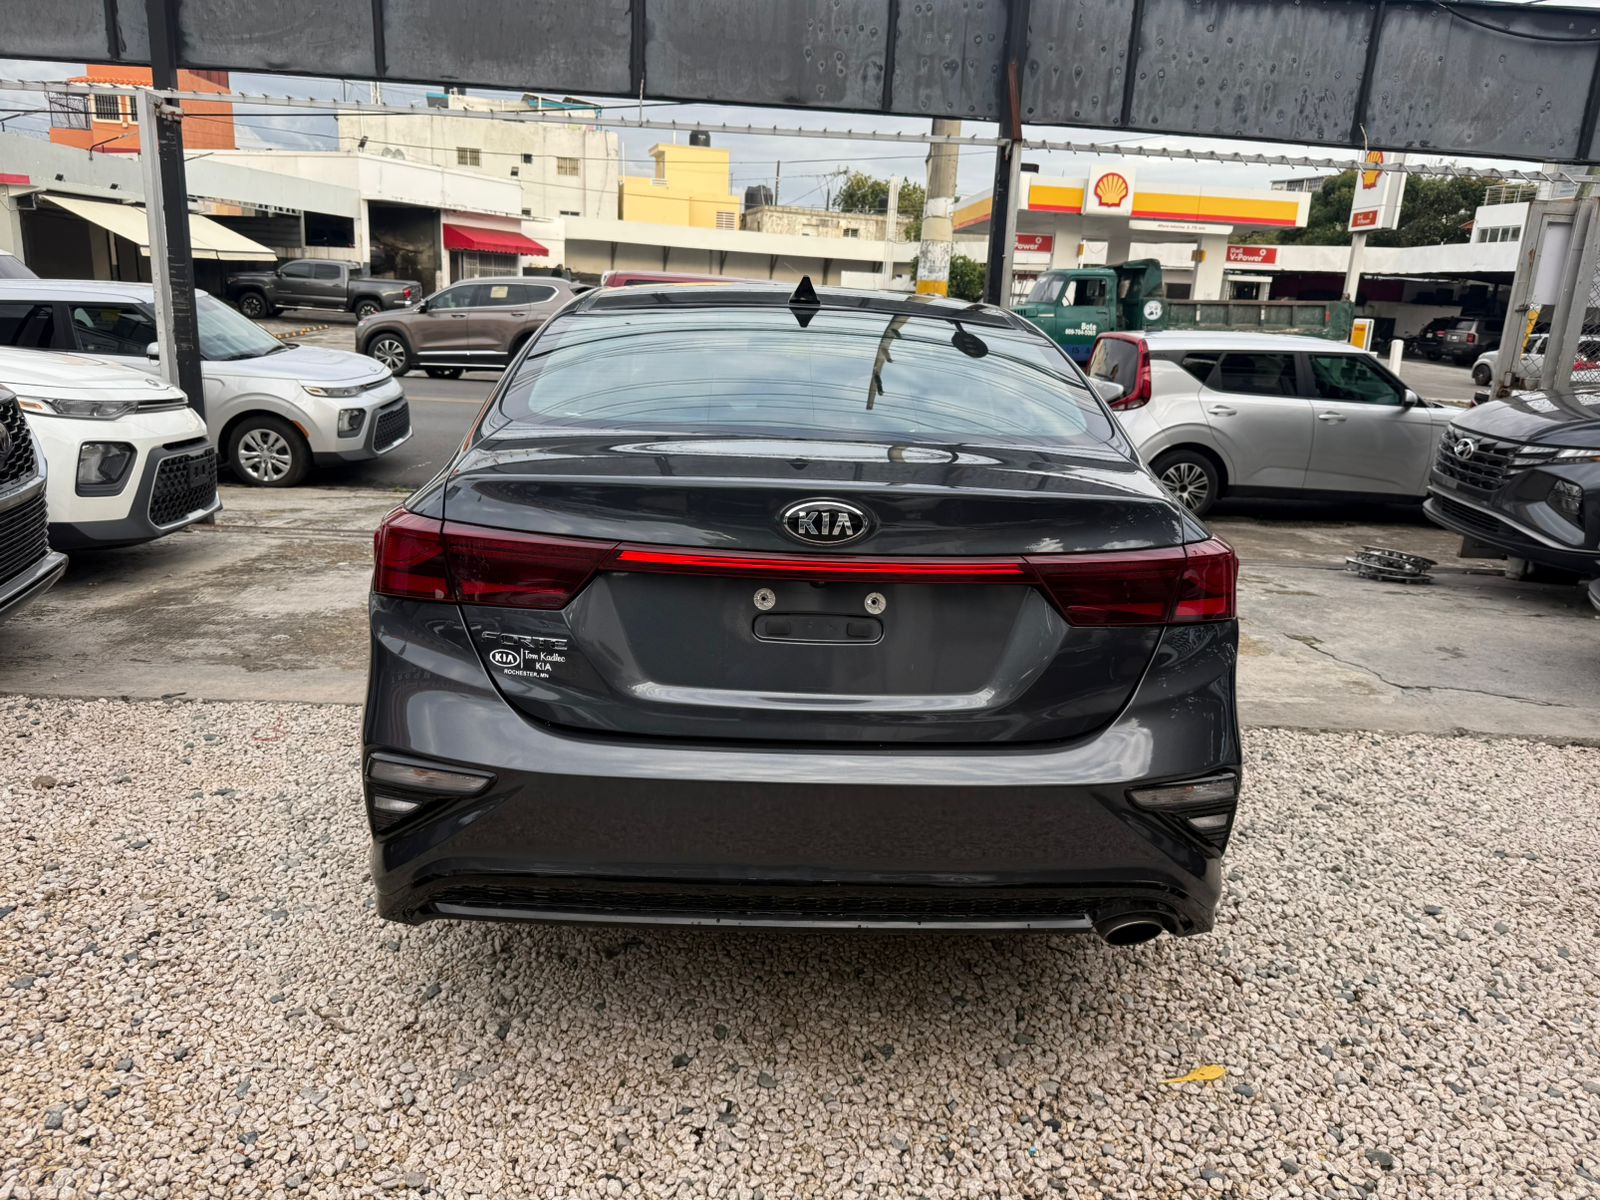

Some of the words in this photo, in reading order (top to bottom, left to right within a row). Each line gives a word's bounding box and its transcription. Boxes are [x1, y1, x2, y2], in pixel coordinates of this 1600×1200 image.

[1230, 252, 1263, 262] V-Power
[798, 511, 854, 535] KIA
[482, 631, 567, 650] FORTE
[494, 652, 515, 664] KIA
[524, 650, 539, 661] Tom
[535, 661, 552, 672] KIA
[503, 668, 540, 678] ROCHESTER,
